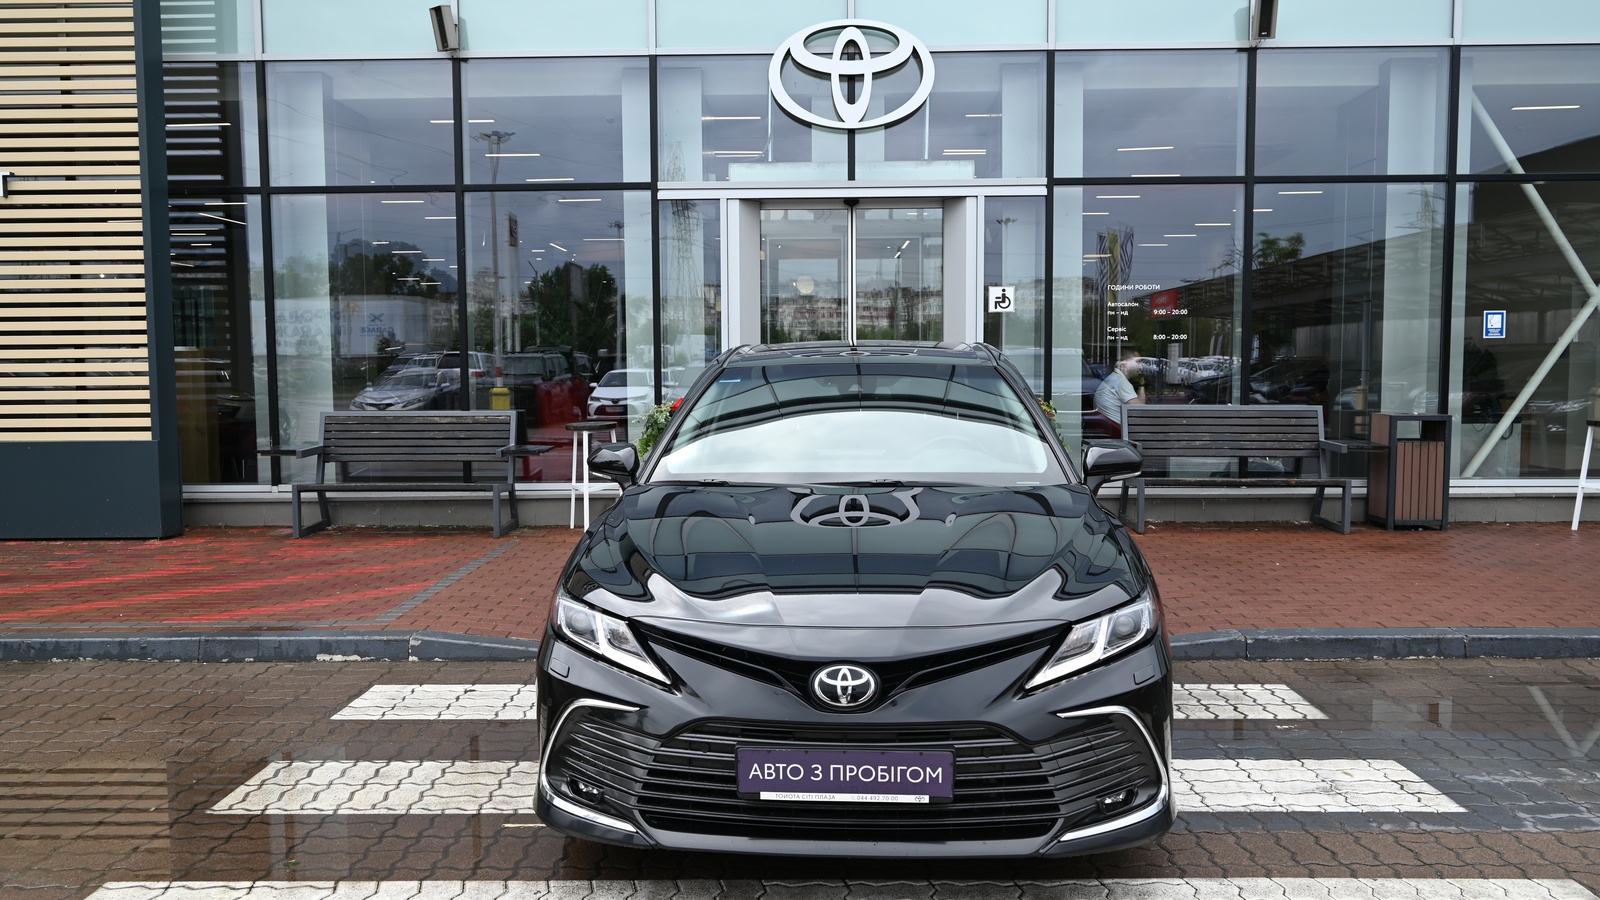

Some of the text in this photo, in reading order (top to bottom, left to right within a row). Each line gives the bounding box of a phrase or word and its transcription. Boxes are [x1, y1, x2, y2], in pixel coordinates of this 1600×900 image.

[749, 763, 943, 784] АВТО З ПРОБІГОМ
